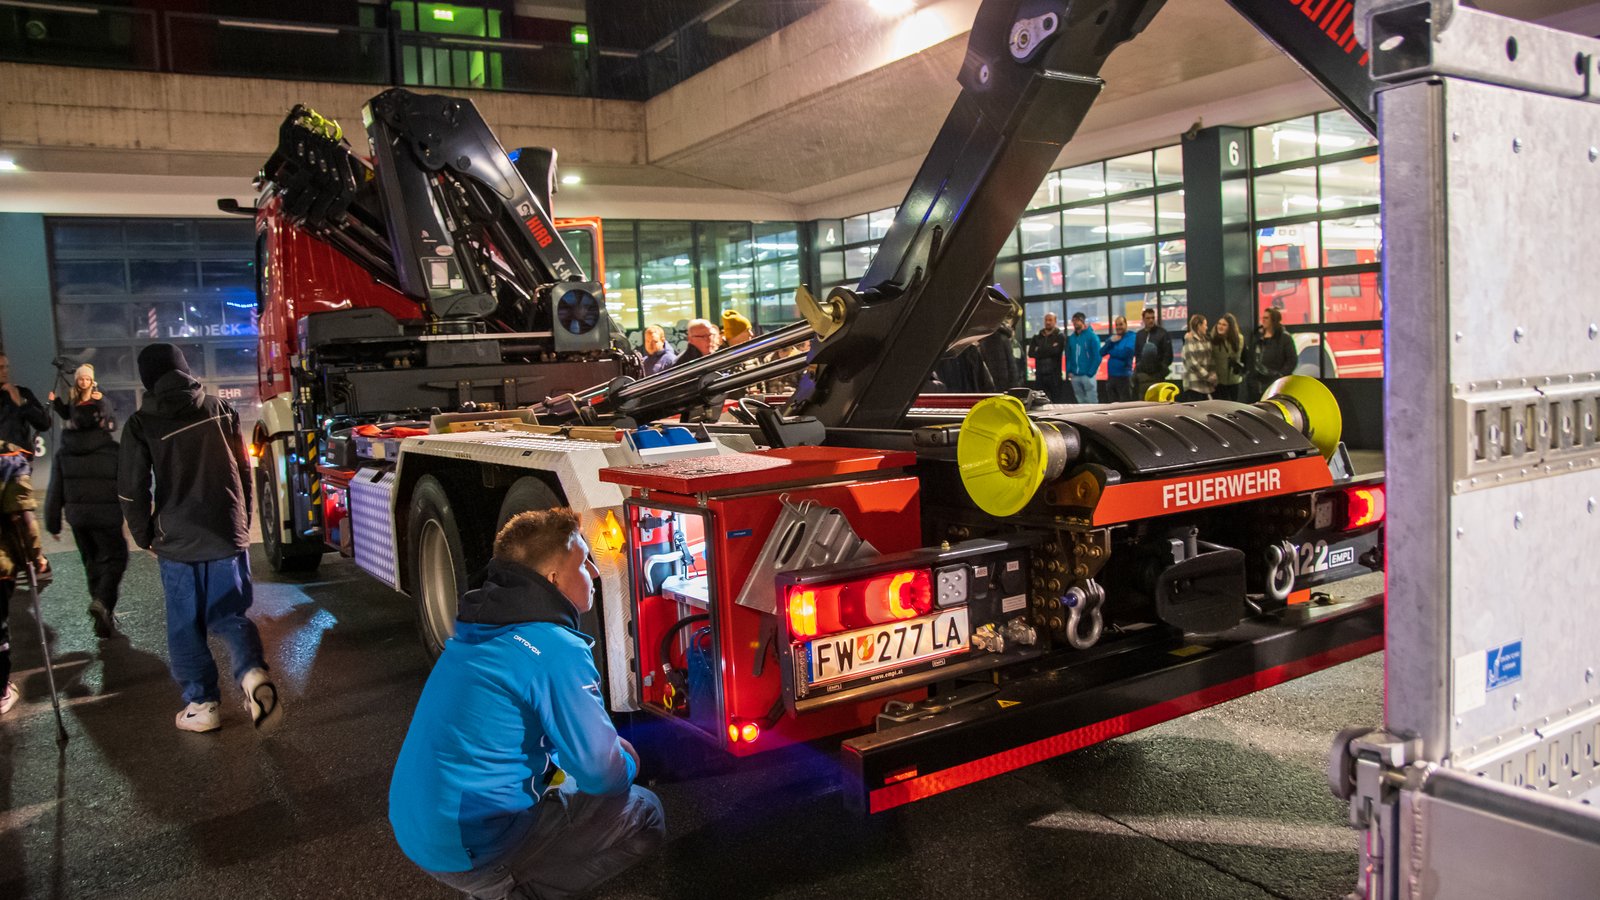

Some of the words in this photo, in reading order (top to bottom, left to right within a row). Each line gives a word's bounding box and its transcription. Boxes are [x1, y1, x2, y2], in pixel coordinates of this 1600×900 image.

[1228, 140, 1239, 166] 6
[526, 216, 553, 248] HIAB
[826, 227, 835, 245] 4
[34, 436, 46, 457] 3
[1162, 468, 1281, 509] FEUERWEHR
[1331, 551, 1352, 564] EMPL
[513, 634, 542, 656] ORTOVOX
[817, 638, 854, 677] FW
[877, 622, 924, 663] 277
[932, 616, 961, 651] LA
